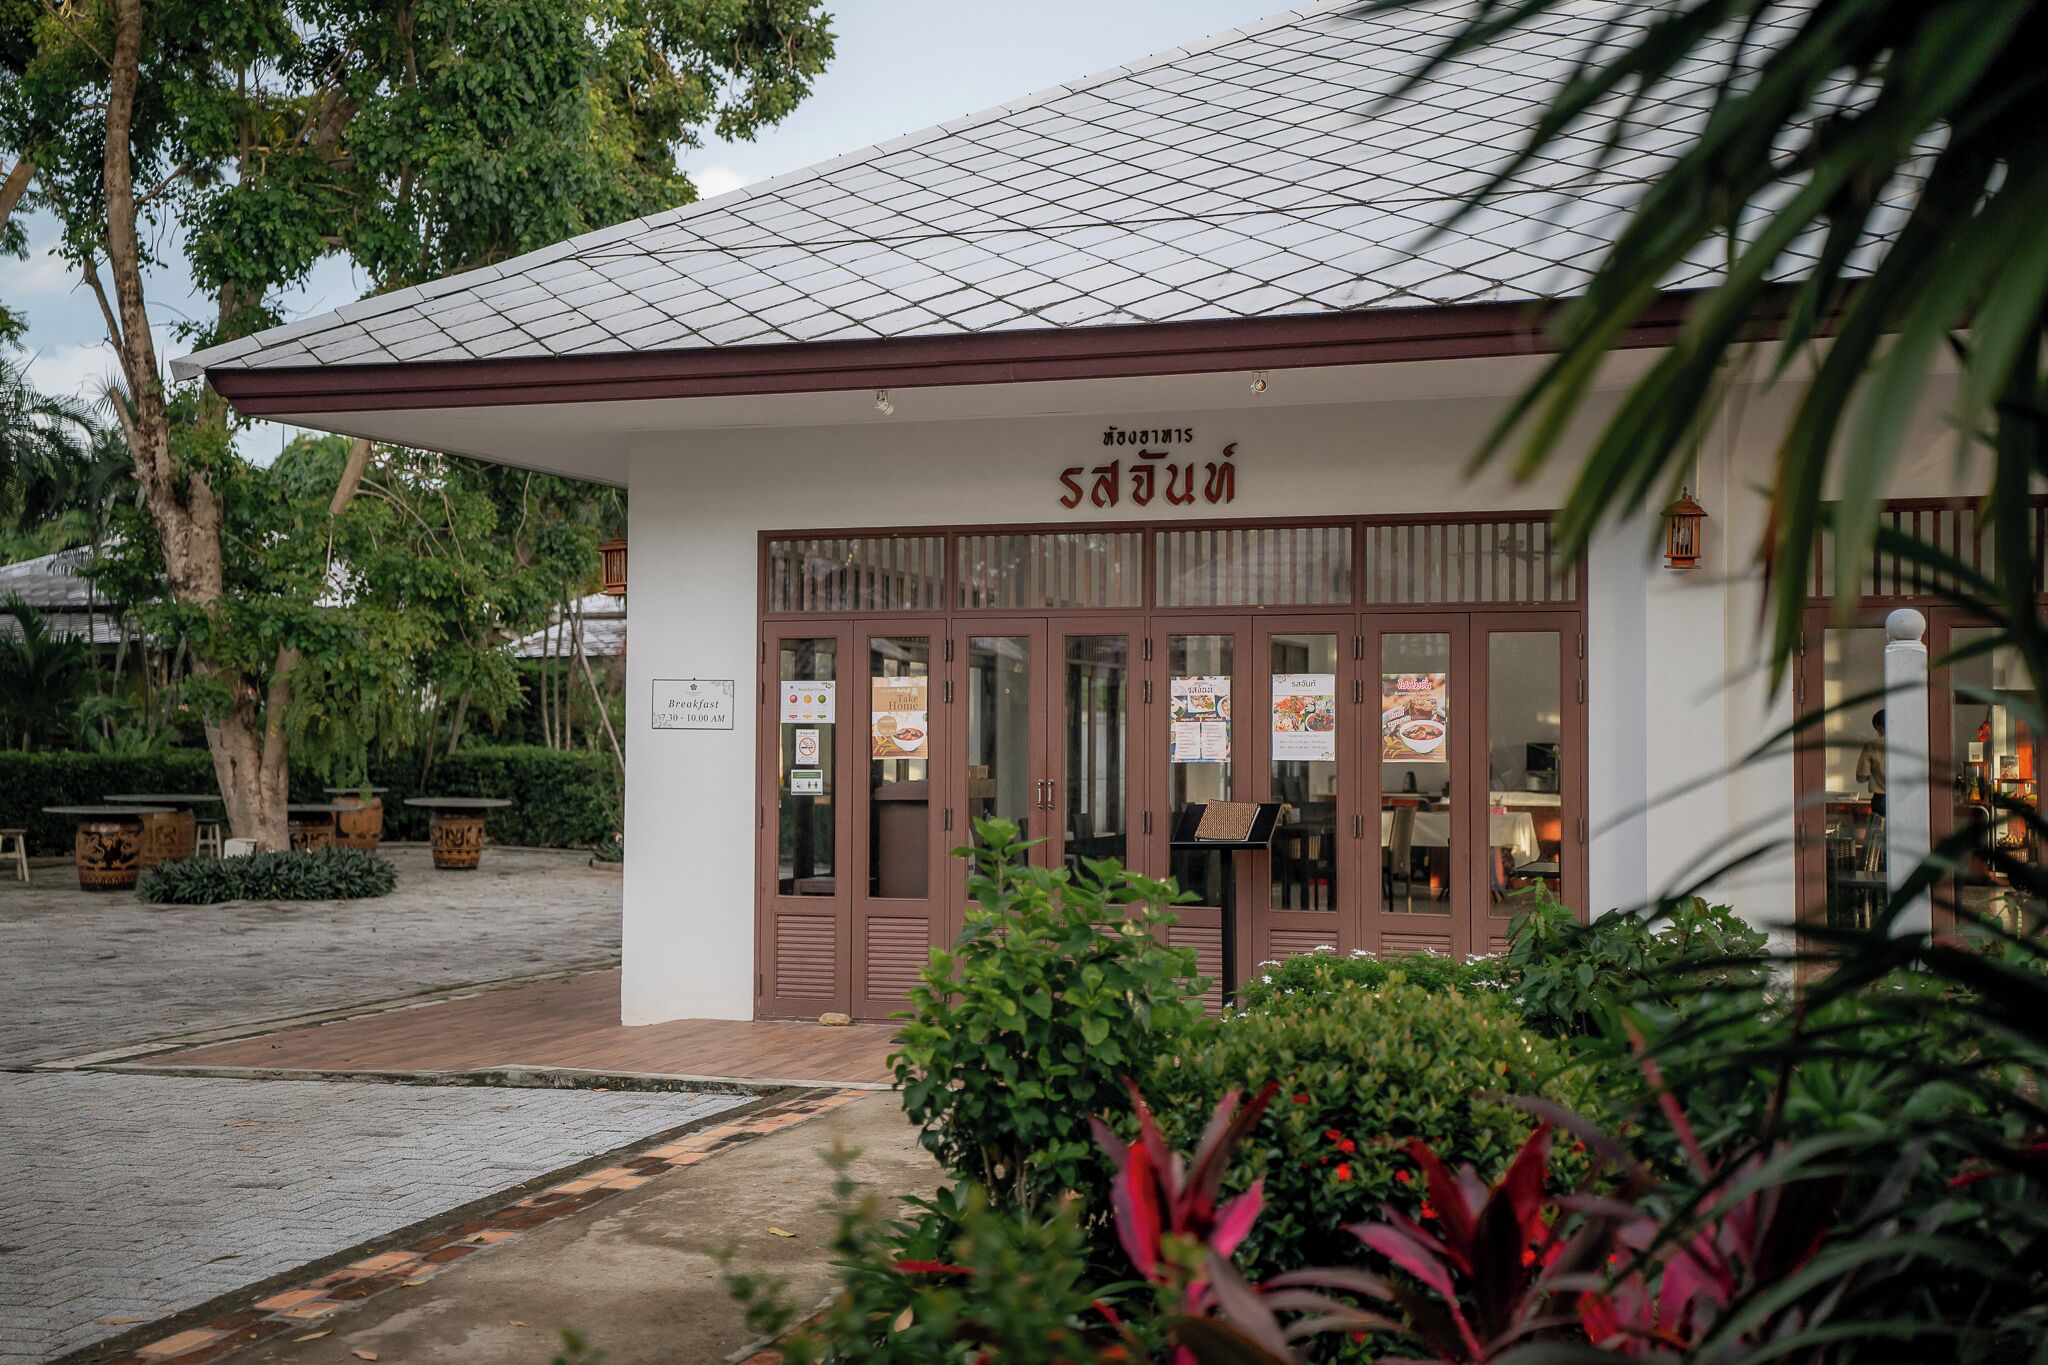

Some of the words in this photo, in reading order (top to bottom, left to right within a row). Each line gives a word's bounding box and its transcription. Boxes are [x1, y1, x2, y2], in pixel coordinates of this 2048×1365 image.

[1102, 426, 1193, 446] ห้องอาหาร
[1059, 442, 1238, 509] รสจันท์
[897, 694, 919, 703] Take
[668, 699, 719, 710] Breakfast
[888, 701, 919, 711] Home
[687, 714, 708, 722] 10.00
